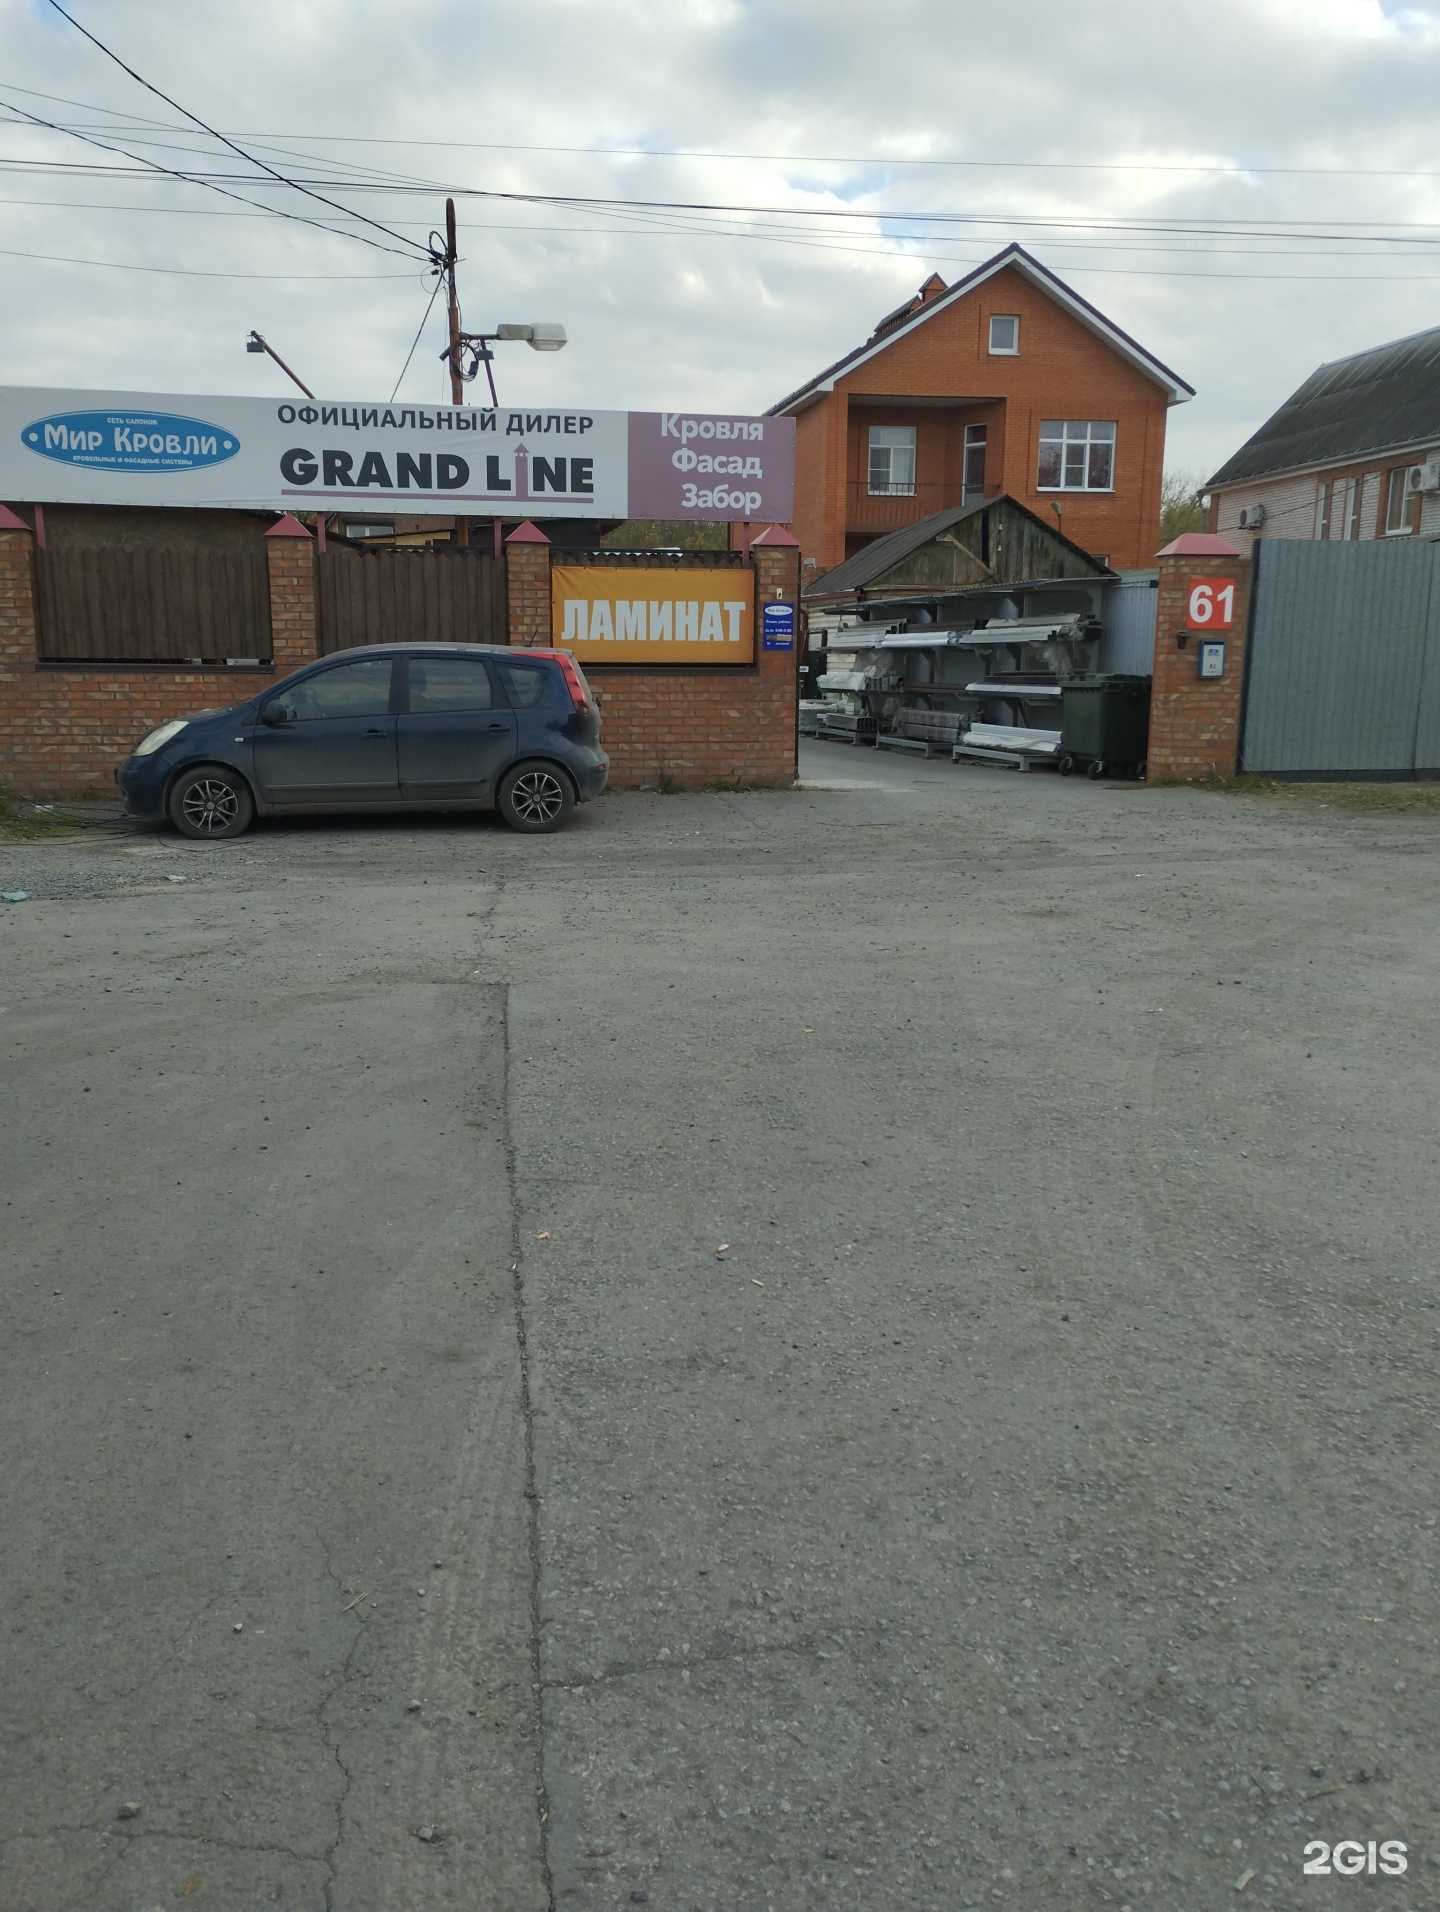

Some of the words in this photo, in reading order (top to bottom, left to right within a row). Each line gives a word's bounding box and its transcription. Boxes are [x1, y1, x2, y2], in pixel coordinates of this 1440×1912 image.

[277, 405, 497, 432] ОФИЦИАЛЬНЫЙ
[505, 413, 594, 436] ДИЛЕР
[661, 413, 764, 444] Кровля
[280, 447, 470, 490] GRAND
[671, 447, 763, 479] Фасад
[681, 483, 762, 515] Забор
[1189, 584, 1235, 623] 61
[561, 599, 746, 642] ЛАМИНАТ
